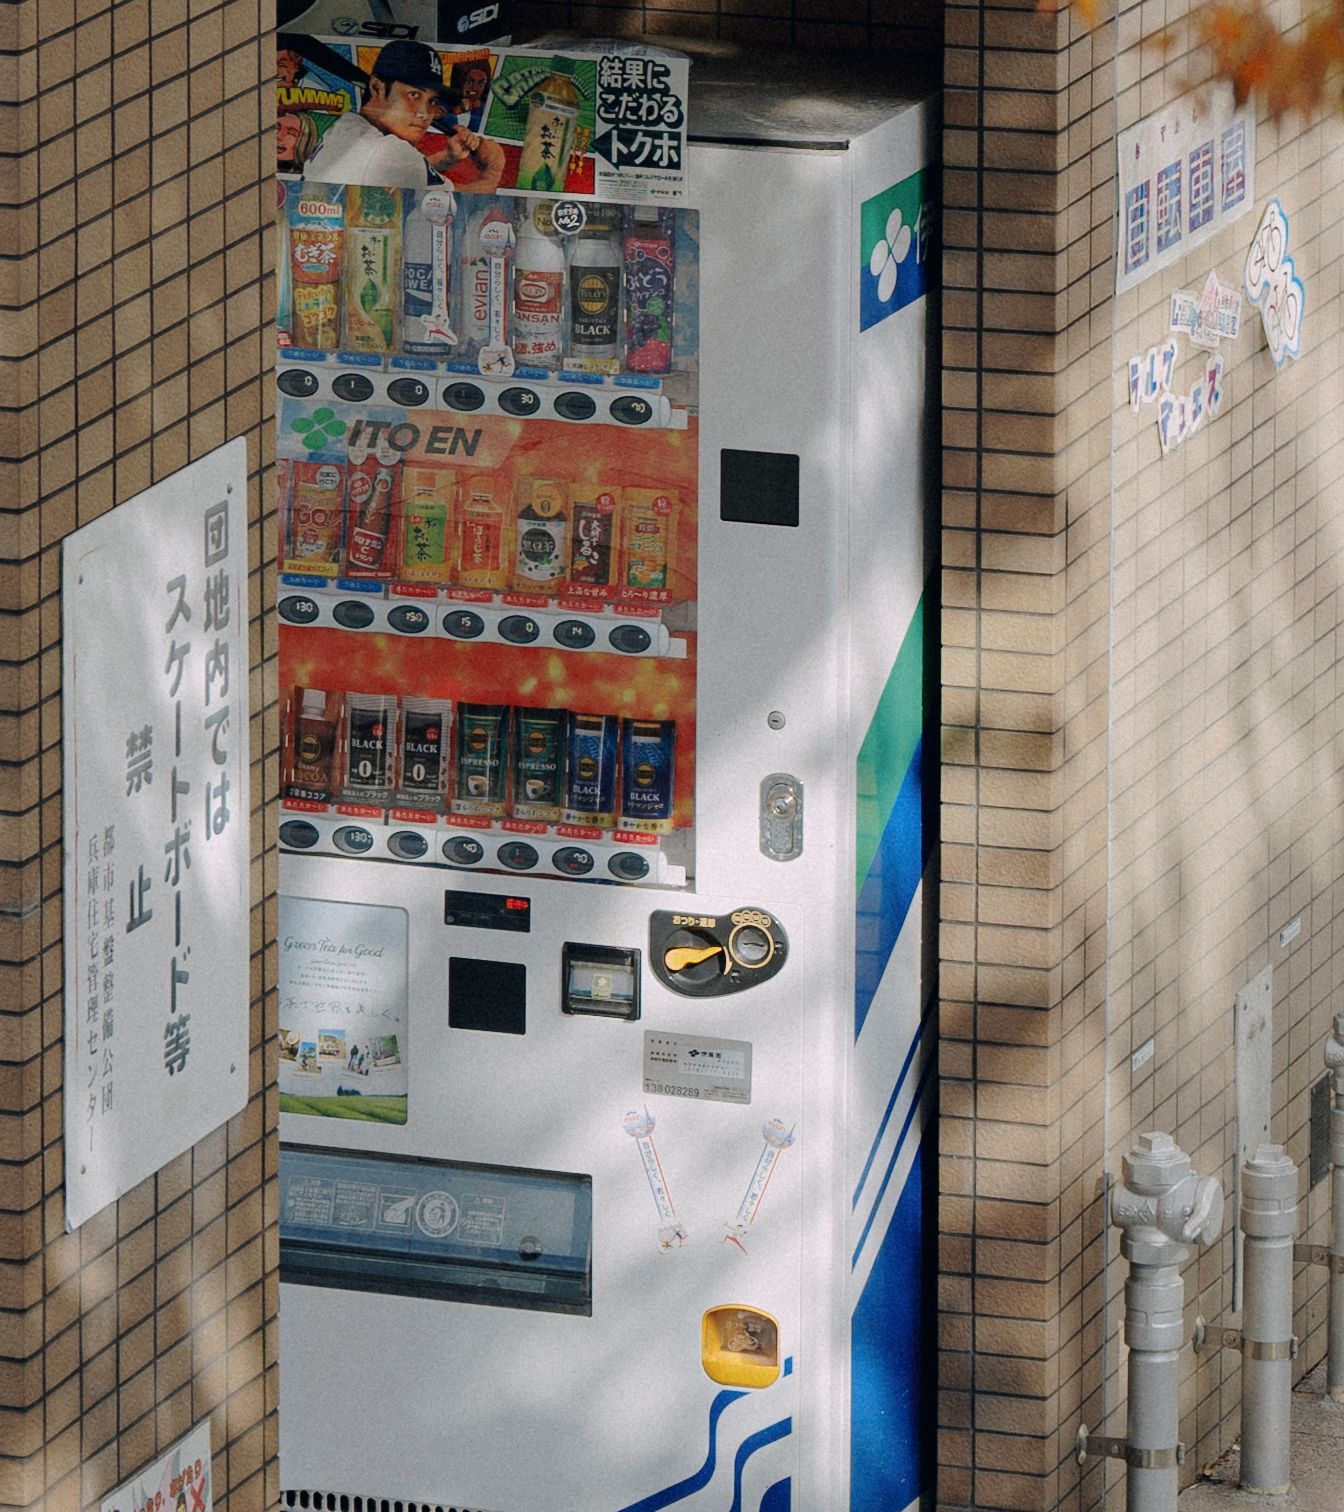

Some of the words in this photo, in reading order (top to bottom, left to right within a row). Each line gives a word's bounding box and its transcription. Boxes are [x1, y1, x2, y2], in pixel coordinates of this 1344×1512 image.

[599, 57, 667, 91] 結果に
[598, 91, 680, 124] こだわる
[611, 128, 680, 168] トクホ
[299, 203, 341, 217] 600ml
[294, 242, 338, 264] むぎ茶
[627, 266, 668, 290] ぶどう
[473, 269, 489, 322] evian
[574, 323, 611, 335] BLACK
[424, 425, 483, 456] EN
[567, 585, 609, 597] 上品な甘み
[204, 499, 230, 842] 団地内では
[351, 737, 384, 750] BLACK
[404, 741, 438, 754] BLACK
[572, 784, 601, 796] BLACK
[629, 792, 661, 802] BLACK
[164, 573, 192, 1077] スケートボード等
[283, 935, 317, 952] Green
[317, 937, 337, 953] Tea
[354, 943, 385, 959] Good
[86, 833, 100, 1153] 兵庫住宅管理センター
